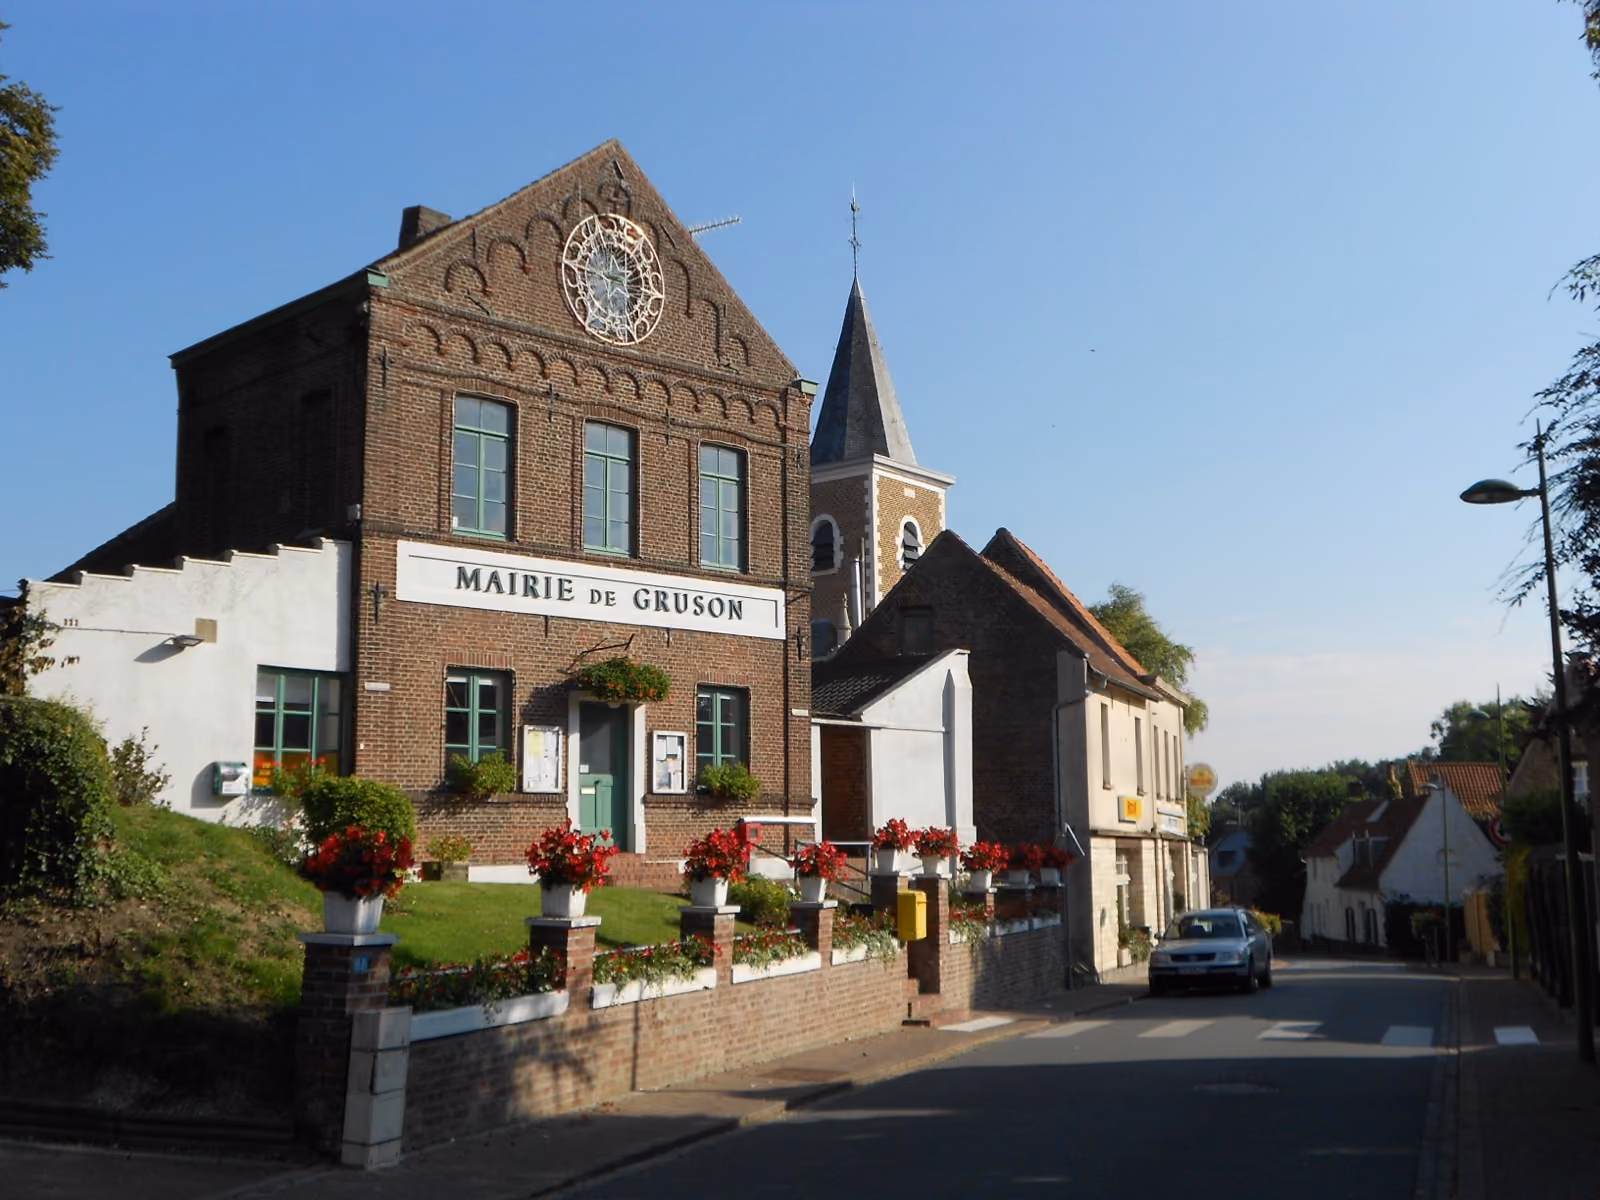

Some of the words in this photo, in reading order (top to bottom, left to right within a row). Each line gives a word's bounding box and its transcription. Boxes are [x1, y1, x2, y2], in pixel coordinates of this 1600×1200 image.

[456, 566, 575, 602] MAIRIE
[589, 588, 617, 607] DE
[633, 587, 743, 621] GRUSON
